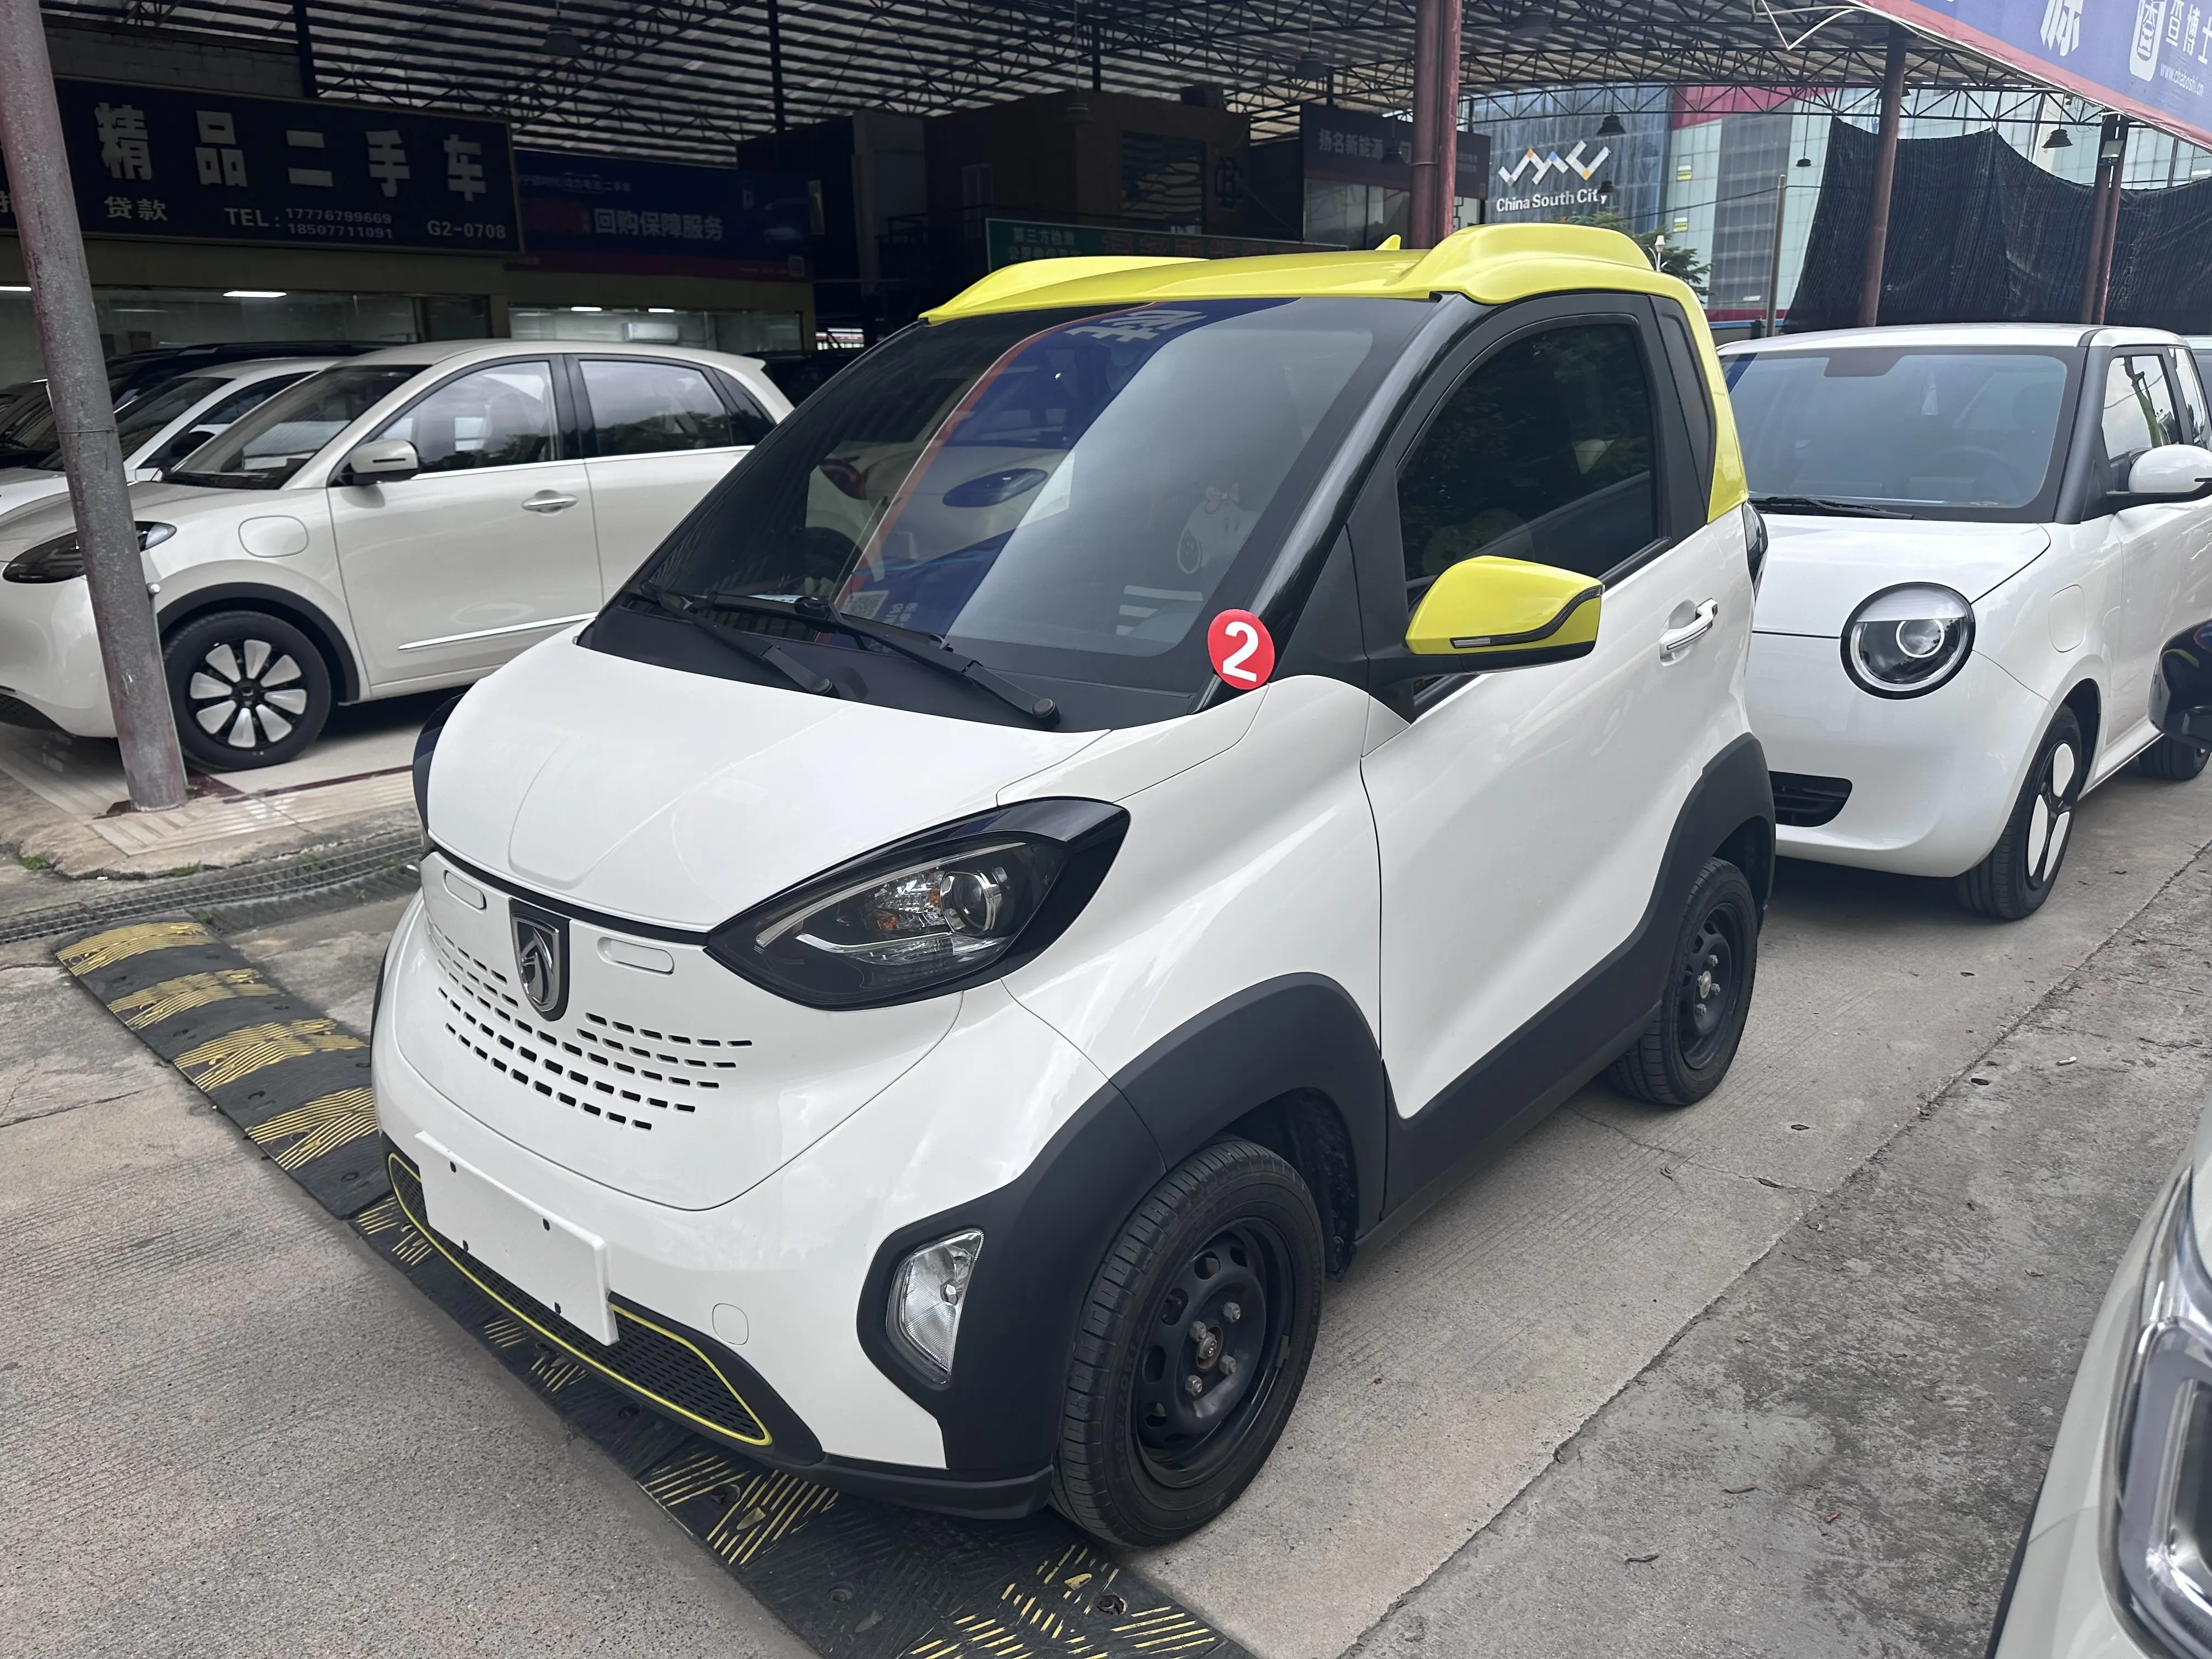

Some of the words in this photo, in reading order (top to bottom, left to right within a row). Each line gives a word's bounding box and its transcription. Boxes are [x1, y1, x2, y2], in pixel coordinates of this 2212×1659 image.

[94, 101, 488, 202] 精品二手车
[103, 195, 168, 222] 贷款
[1496, 197, 1531, 212] China
[1532, 190, 1575, 207] South
[1576, 189, 1608, 205] City
[426, 220, 507, 240] G2-0708
[593, 207, 725, 241] 回购保障服务
[1222, 620, 1259, 683] 2
